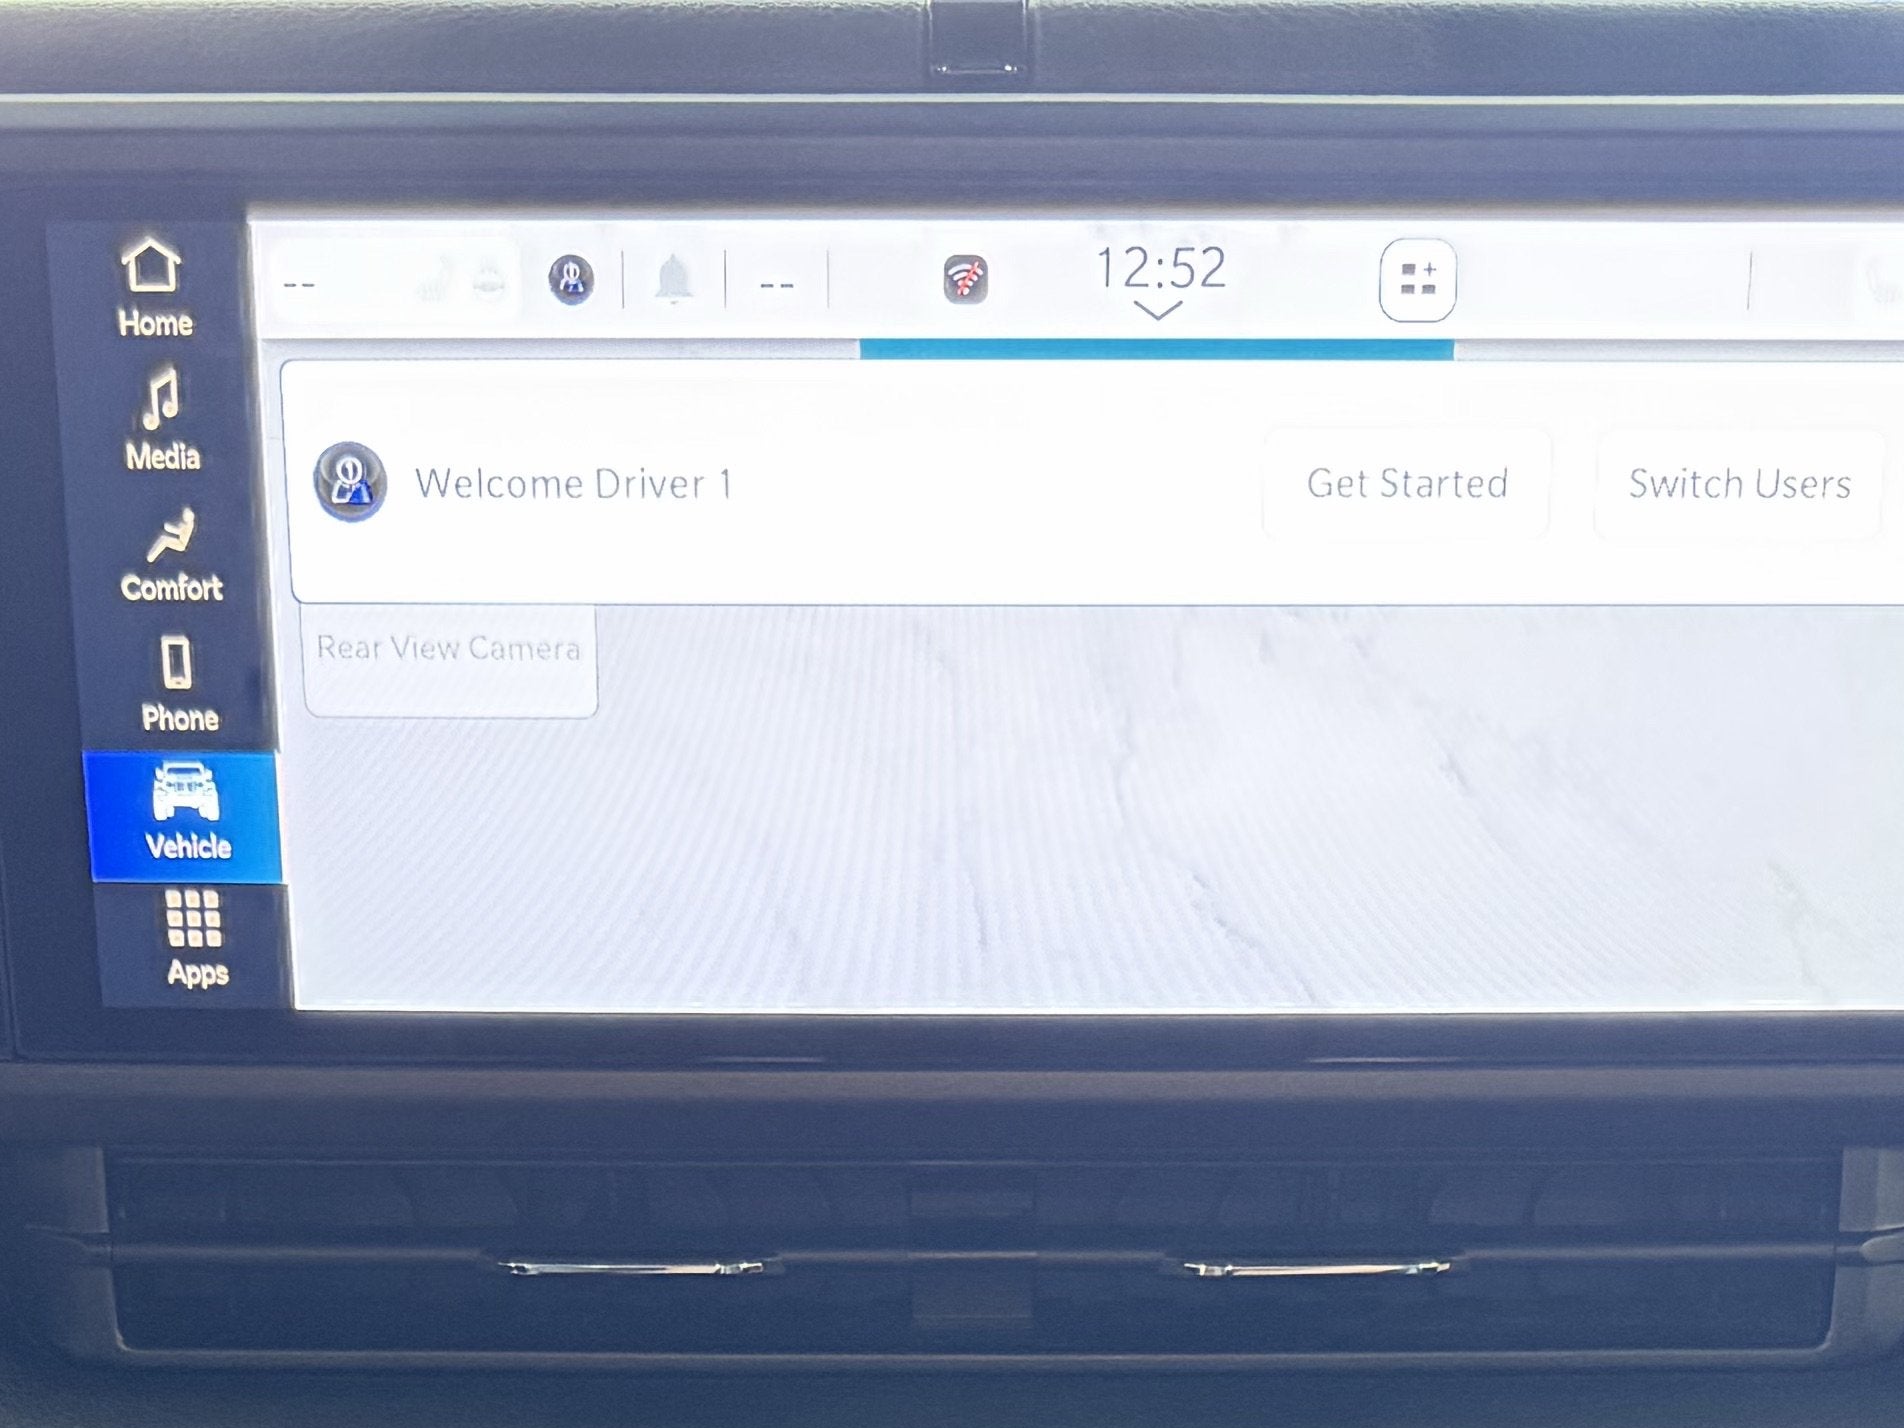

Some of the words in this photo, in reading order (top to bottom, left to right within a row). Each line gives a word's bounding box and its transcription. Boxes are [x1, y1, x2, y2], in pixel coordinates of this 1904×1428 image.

[1098, 246, 1228, 289] 12:52
[118, 310, 193, 338] Home
[125, 442, 201, 472] Media
[415, 467, 584, 500] Welcome
[596, 467, 705, 500] Driver
[719, 467, 732, 500] 1
[1308, 467, 1368, 499] Get
[1380, 467, 1510, 500] Started
[1628, 467, 1744, 500] Switch
[1754, 468, 1852, 501] Users
[121, 574, 225, 603] Comfort
[318, 633, 382, 662] Rear
[391, 633, 460, 662] View
[469, 634, 582, 662] Camera
[141, 702, 220, 732] Phone
[144, 832, 233, 861] Vehicle
[167, 960, 230, 990] Apps
